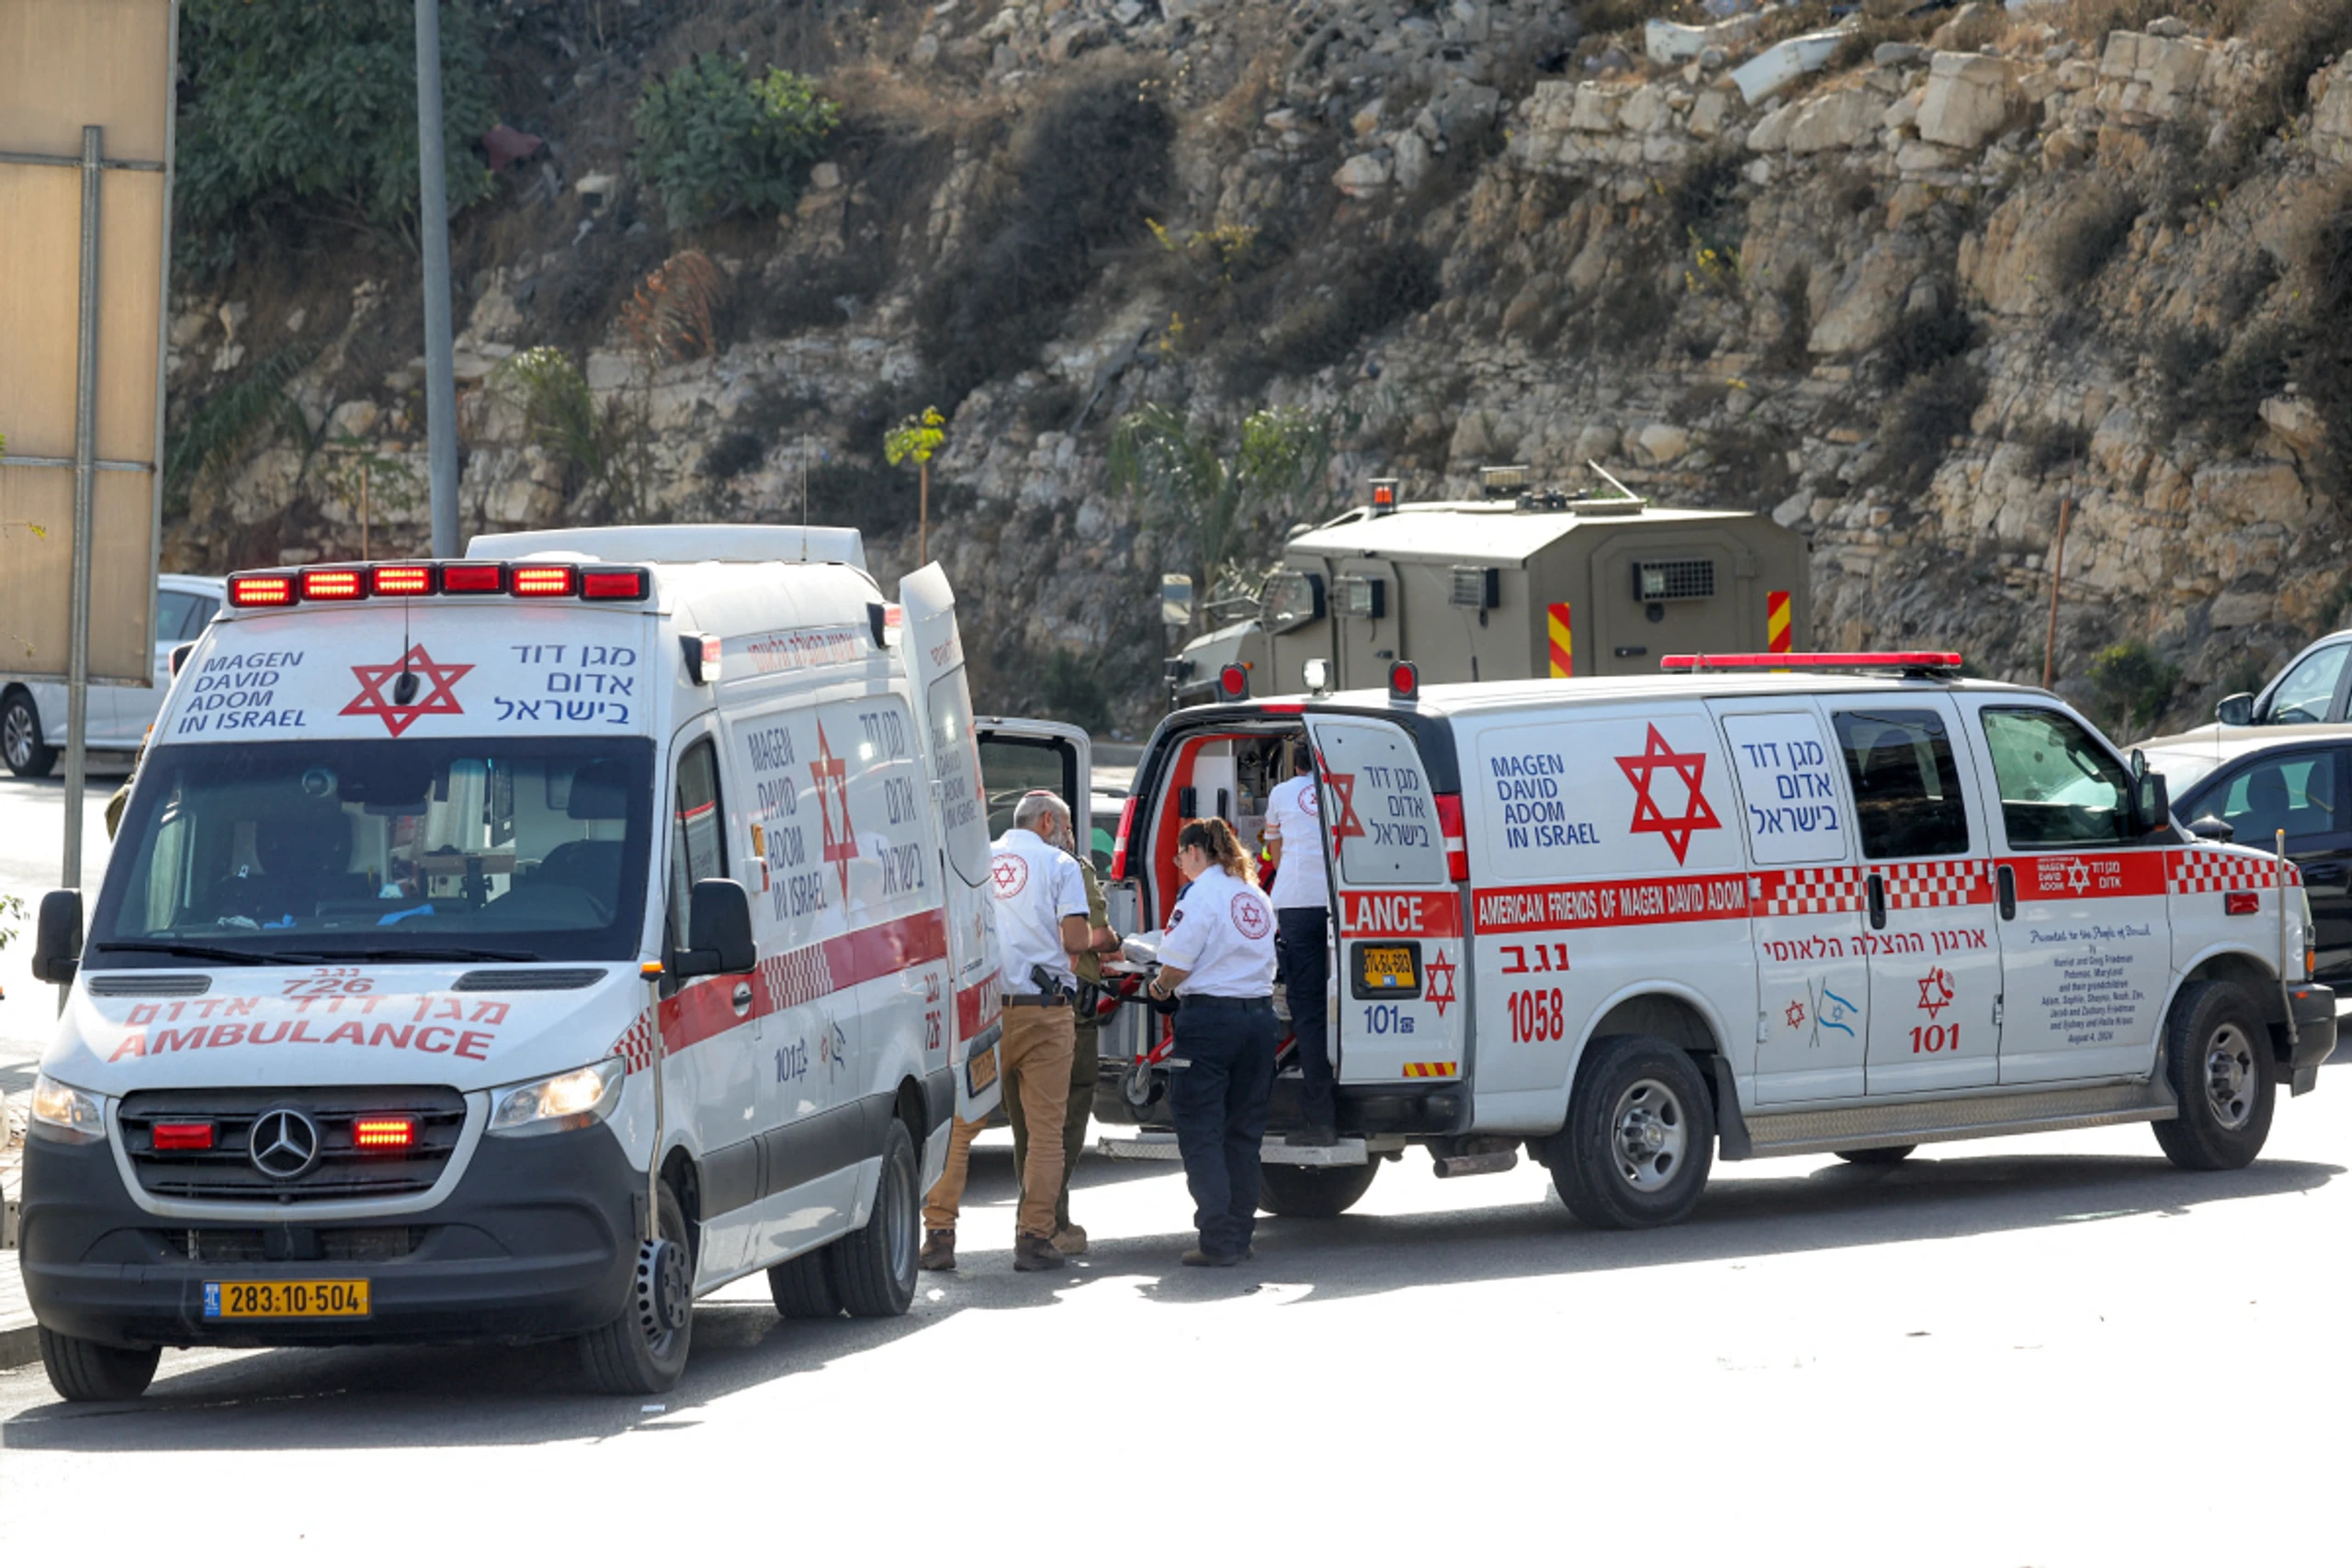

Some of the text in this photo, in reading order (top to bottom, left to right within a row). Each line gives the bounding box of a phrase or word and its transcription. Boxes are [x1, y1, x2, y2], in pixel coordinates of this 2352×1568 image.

[204, 651, 304, 673] MAGEN
[510, 645, 637, 668] מגן דוד
[195, 671, 279, 693] DAVID
[547, 672, 634, 696] אדום
[187, 691, 274, 713] ADOM
[494, 696, 629, 725] בישראל
[178, 710, 307, 734] IN ISRAEL
[881, 710, 905, 760] מגן
[747, 727, 795, 773] MAGEN
[1742, 741, 1824, 770] מגן דוד
[1363, 766, 1419, 794] מגן דוד
[1491, 753, 1565, 778] MAGEN
[757, 776, 797, 822] DAVID
[884, 777, 917, 825] אדום
[1497, 777, 1558, 801] DAVID
[1777, 773, 1833, 800] אדום
[1387, 795, 1425, 818] אדום
[1505, 801, 1566, 825] ADOM
[1750, 805, 1838, 835] בישראל
[1370, 818, 1430, 848] בישראל
[1507, 823, 1600, 849] IN ISRAEL
[768, 825, 806, 872] ADOM
[876, 838, 924, 896] בישראל
[2039, 872, 2062, 881] DAVID
[772, 872, 828, 922] IN ISRAEL
[2040, 882, 2065, 890] ADOM
[1340, 895, 1424, 932] LANCE
[1479, 879, 1746, 927] AMERICAN FRIENDS OF MAGEN DAVID ADOM
[1499, 942, 1570, 974] נגב
[1763, 928, 1987, 962] ארגון ההצלה הלאומי
[282, 978, 374, 995] 726
[312, 967, 360, 977] נגב
[124, 995, 510, 1027] מגן דוד אדום
[1364, 1004, 1398, 1034] 101
[1508, 987, 1563, 1043] 1058
[107, 1021, 495, 1063] AMBULANCE
[925, 1010, 941, 1053] 726
[1909, 1022, 1959, 1054] 101
[775, 1049, 796, 1082] 101
